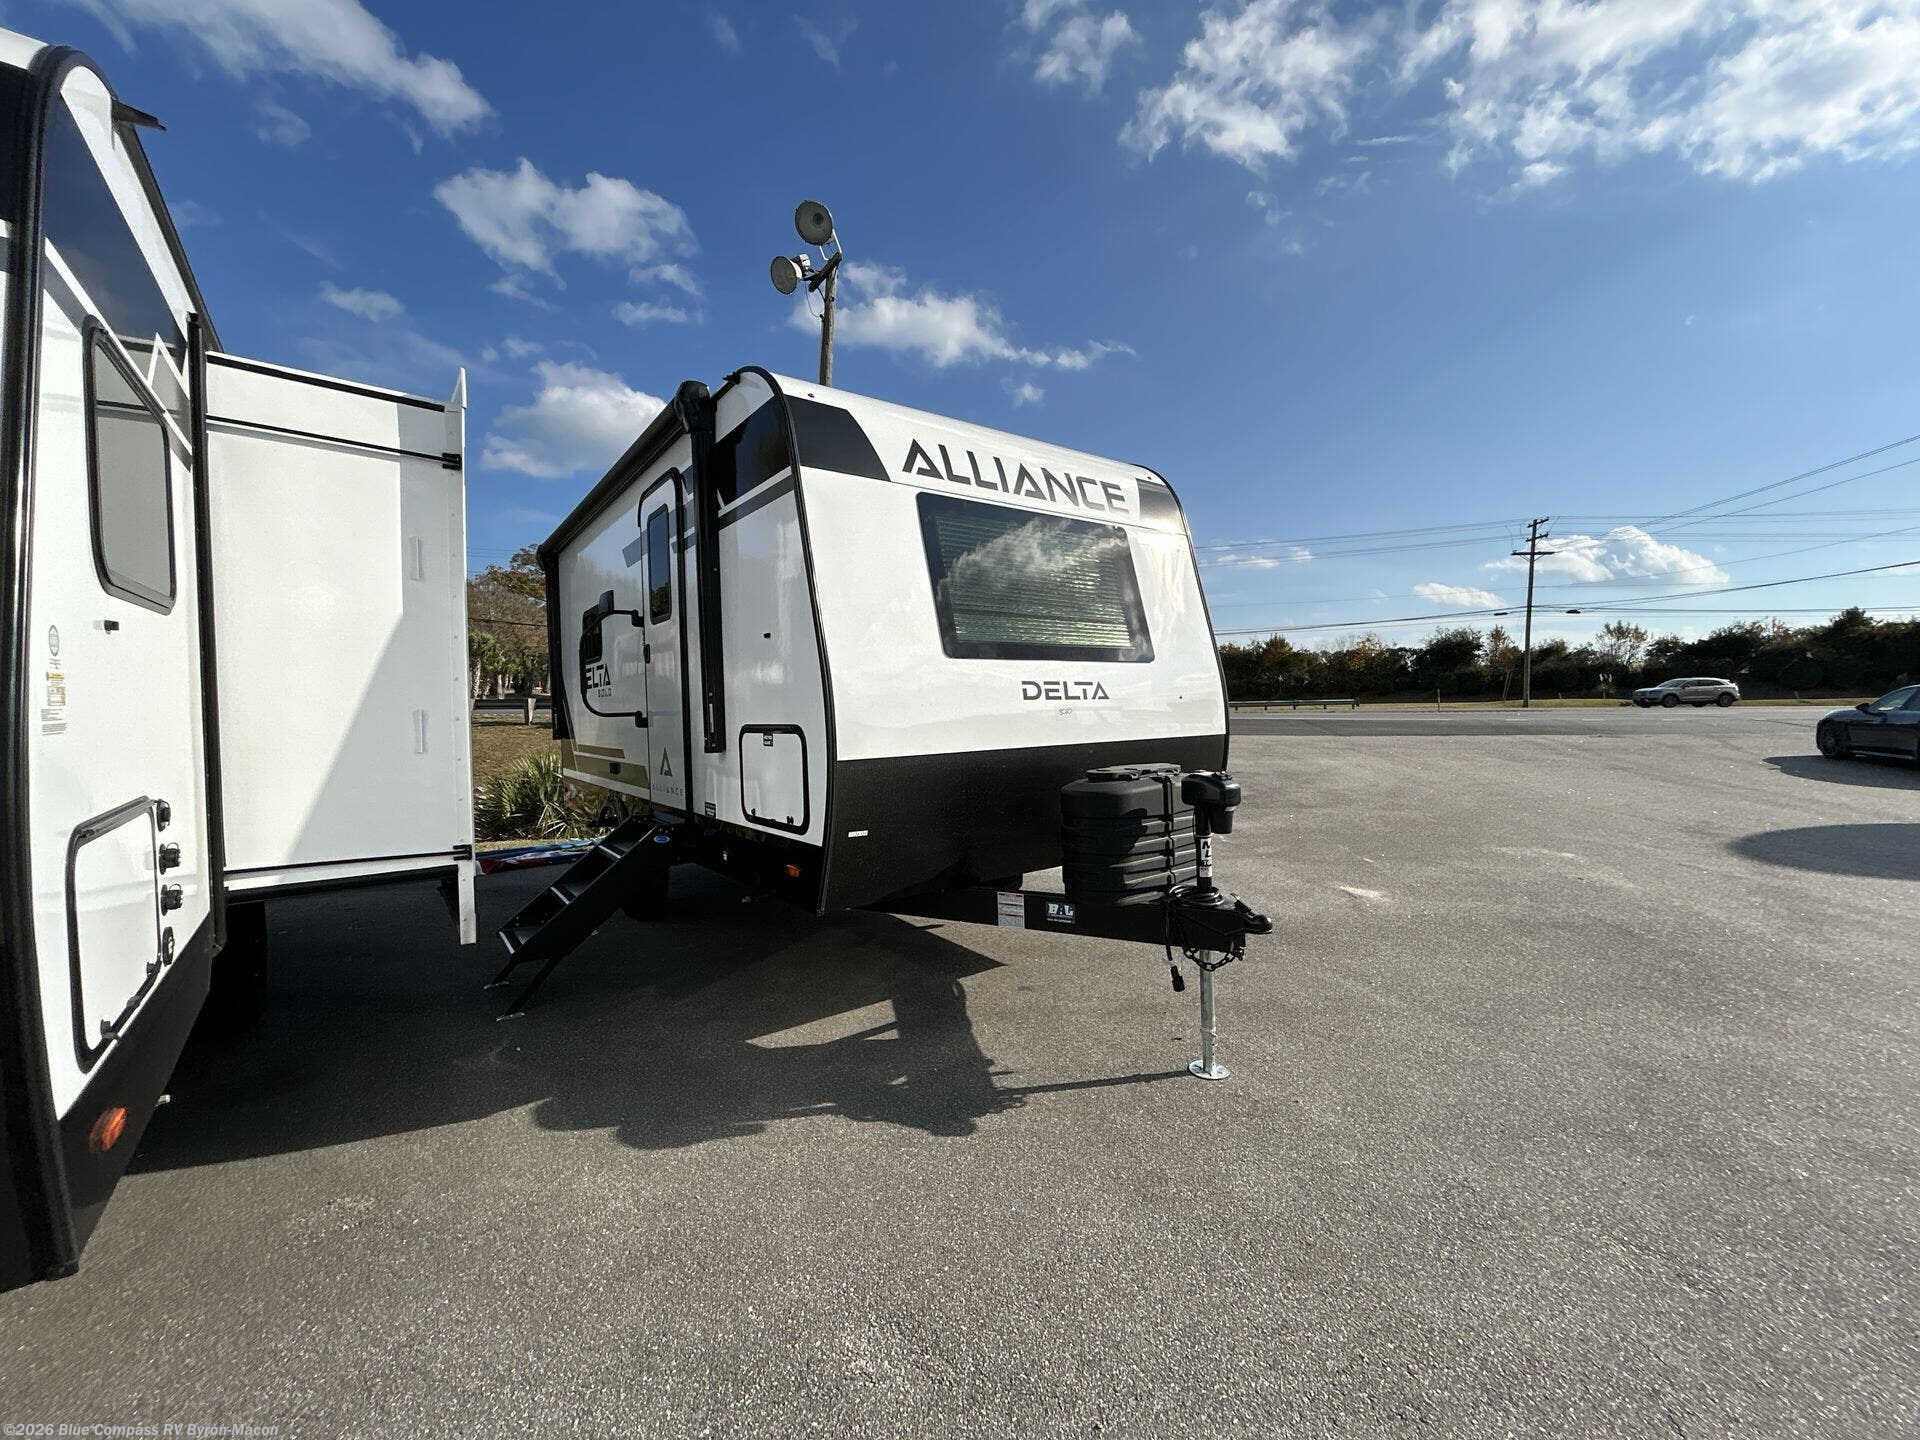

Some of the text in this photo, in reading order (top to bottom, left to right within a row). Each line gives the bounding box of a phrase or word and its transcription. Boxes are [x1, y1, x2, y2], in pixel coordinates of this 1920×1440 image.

[902, 438, 1130, 515] ALLIANCE
[585, 663, 612, 689] ELTA
[1021, 680, 1110, 700] DELTA
[652, 782, 684, 797] ALLIANCE
